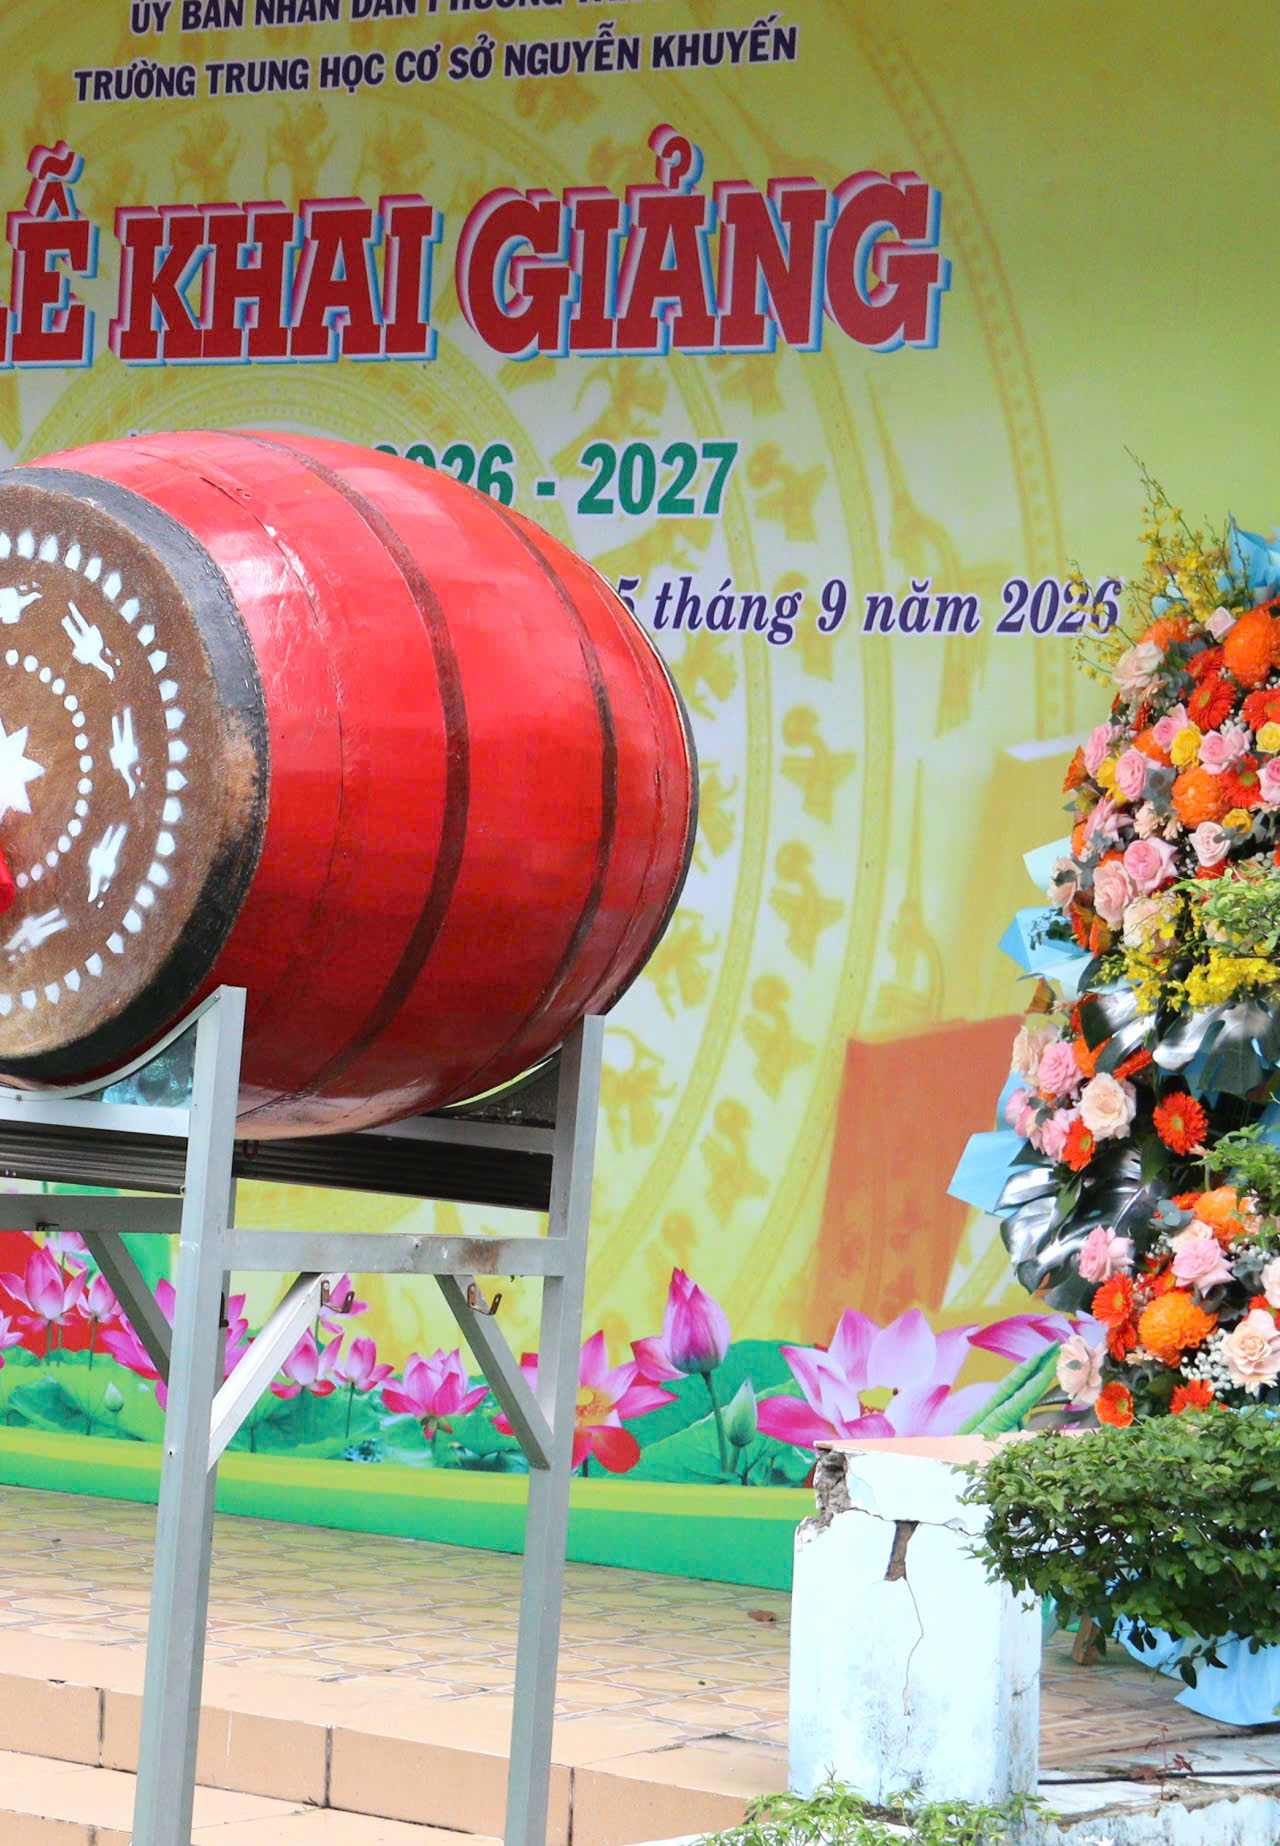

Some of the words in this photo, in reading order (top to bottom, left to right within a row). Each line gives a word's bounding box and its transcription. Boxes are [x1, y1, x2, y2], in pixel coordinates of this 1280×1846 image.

[181, 0, 243, 31] BAN
[74, 59, 196, 101] TRƯỜNG
[205, 58, 309, 95] TRUNG
[320, 53, 385, 93] HỌC
[395, 45, 440, 83] CƠ
[448, 33, 496, 80] SỞ
[504, 22, 640, 77] NGUYỄN
[652, 15, 797, 69] KHUYẾN
[109, 194, 439, 366] KHAI
[456, 123, 952, 361] GIẢNG
[577, 442, 738, 515] 2027
[654, 576, 802, 645] tháng
[818, 579, 847, 632] 9
[863, 579, 980, 634] năm
[996, 579, 1121, 634] 2026
